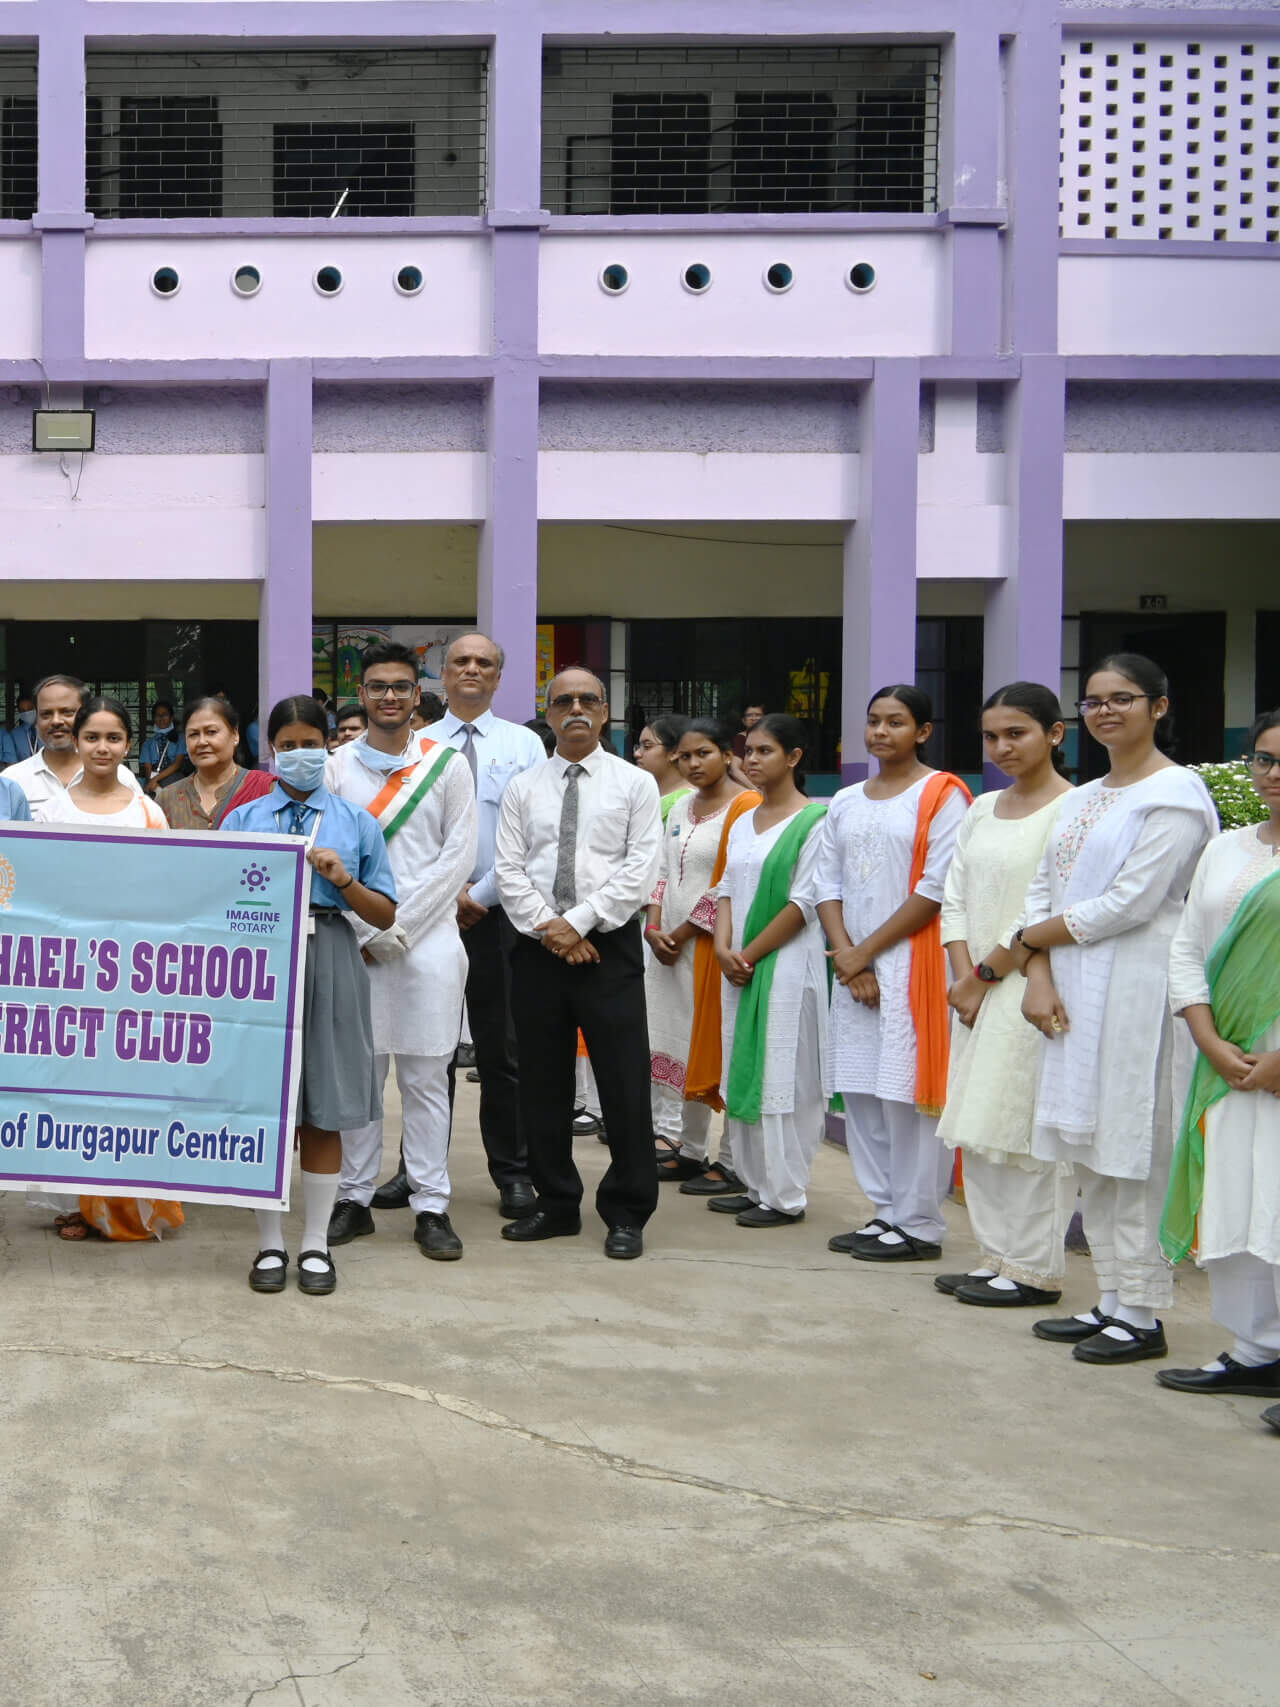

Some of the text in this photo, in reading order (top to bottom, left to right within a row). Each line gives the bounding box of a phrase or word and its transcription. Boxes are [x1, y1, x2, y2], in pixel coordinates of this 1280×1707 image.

[226, 909, 281, 923] IMAGINE
[230, 921, 276, 934] ROTARY
[130, 940, 276, 1002] SCHOOL
[114, 1008, 213, 1065] CLUB
[0, 1111, 29, 1148] of
[35, 1113, 160, 1162] Durgapur
[168, 1121, 266, 1163] Central
